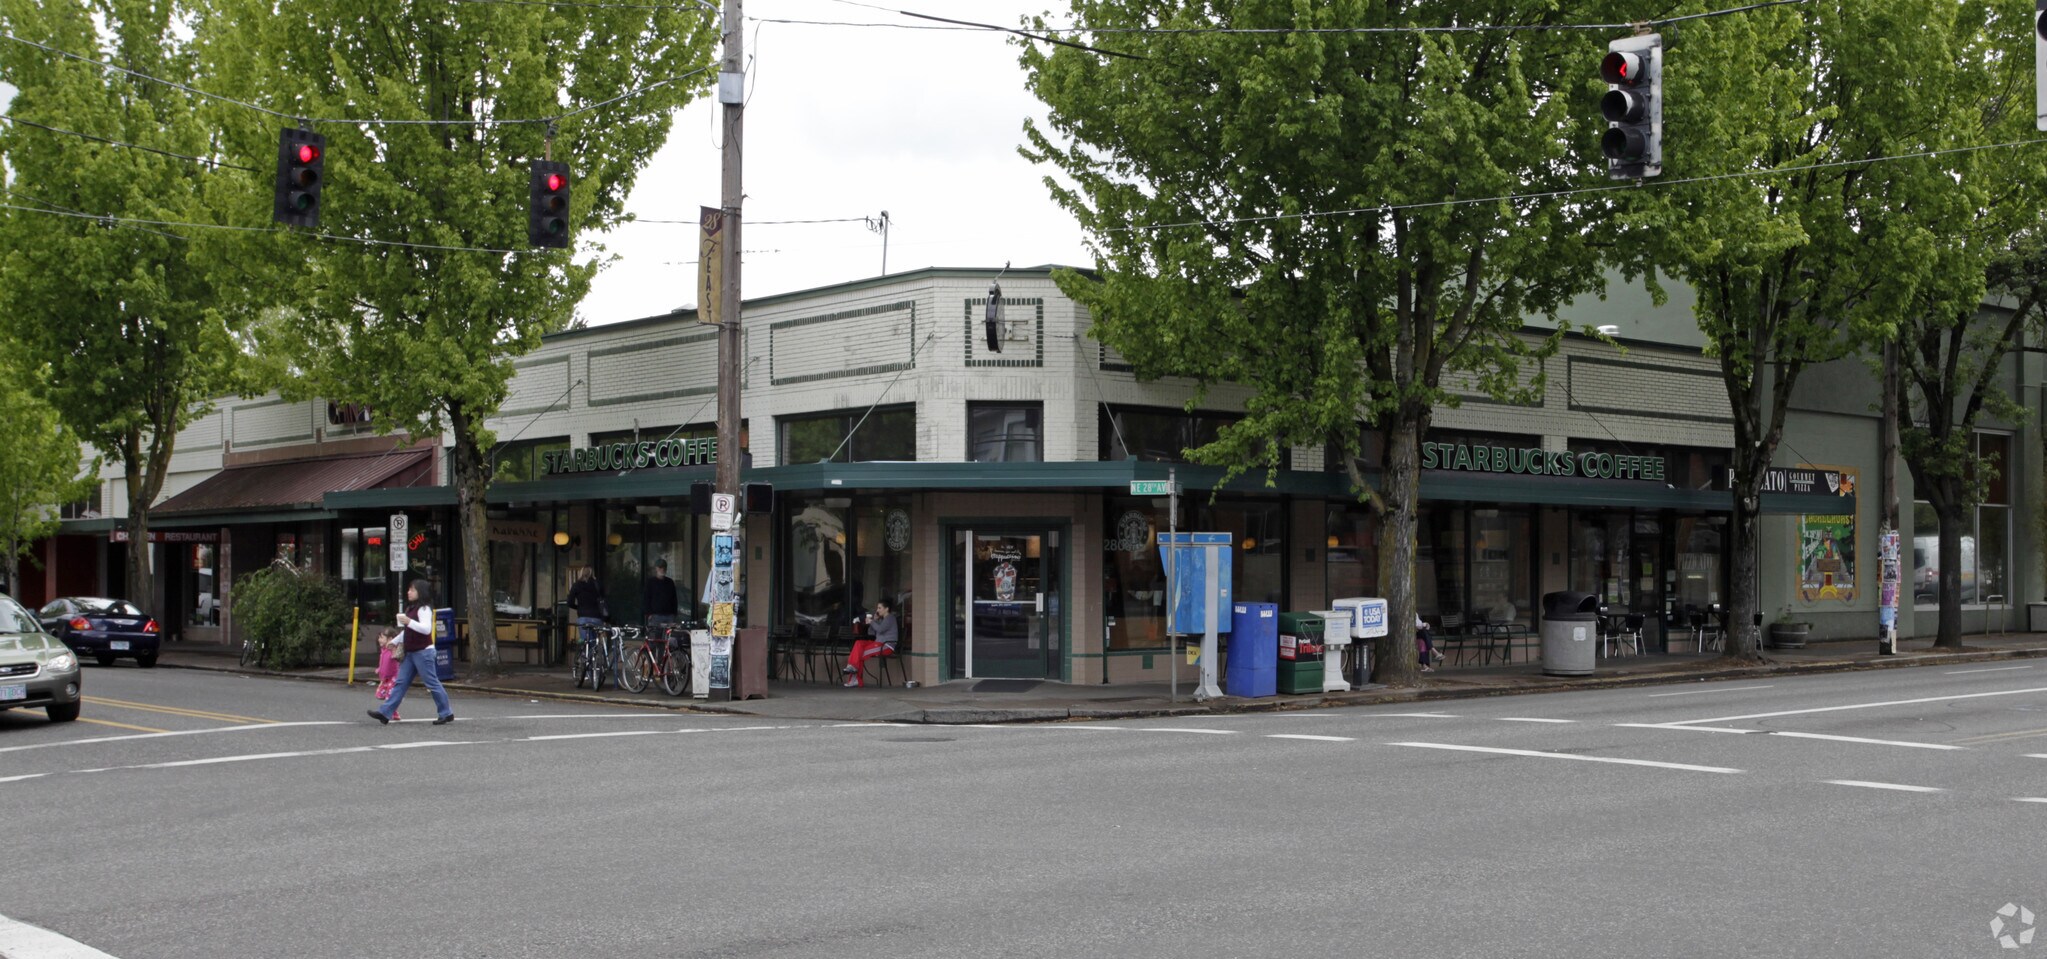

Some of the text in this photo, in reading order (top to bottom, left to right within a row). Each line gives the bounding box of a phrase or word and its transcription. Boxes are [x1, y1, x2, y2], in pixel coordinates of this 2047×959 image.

[703, 213, 720, 231] 28
[541, 437, 718, 474] STARBUCKS COFFE
[1422, 441, 1665, 480] STARBUCKS COFFEE
[1131, 483, 1141, 493] NE
[1794, 483, 1811, 492] PIZZA
[164, 533, 217, 541] RESTAURANT
[1368, 608, 1380, 616] USA
[1363, 613, 1382, 624] TODAY
